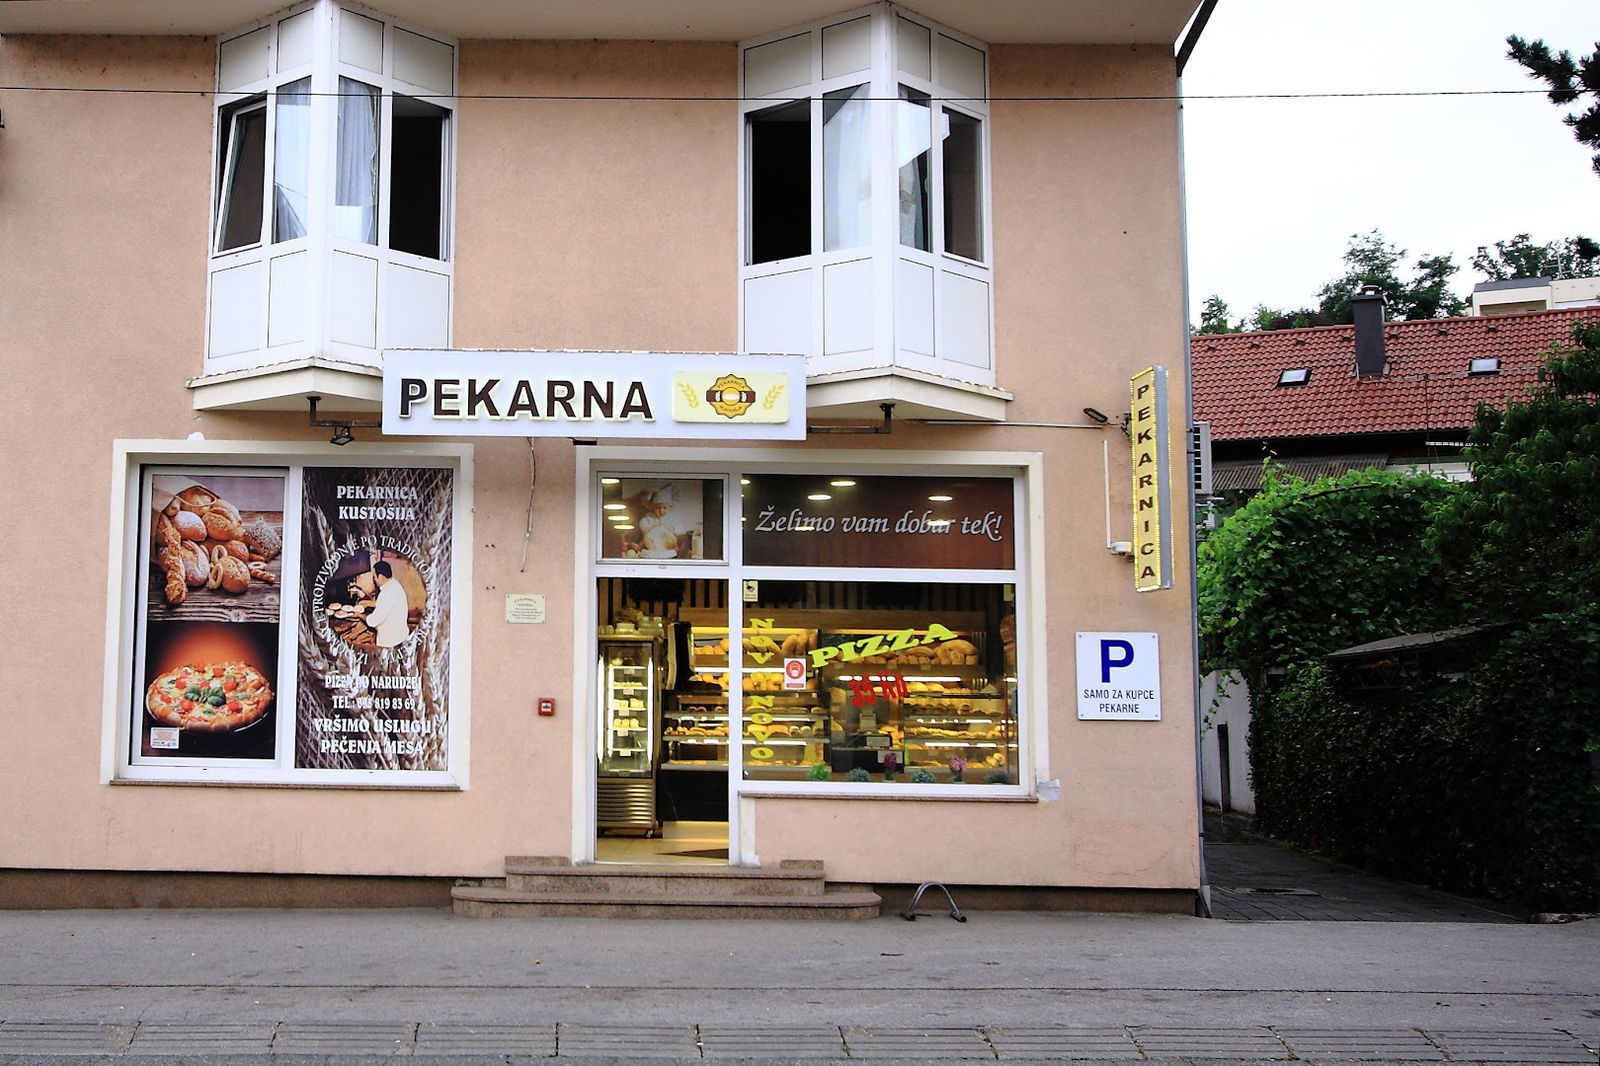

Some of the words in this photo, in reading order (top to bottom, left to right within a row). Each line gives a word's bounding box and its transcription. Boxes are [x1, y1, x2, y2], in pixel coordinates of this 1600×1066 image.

[399, 378, 655, 421] PEKARNA
[1136, 384, 1156, 579] PEKARNICA
[336, 485, 418, 500] PEKARNICA
[338, 503, 416, 520] KUSTOŠIJA
[754, 505, 836, 533] Želimo
[841, 515, 890, 533] vam
[894, 508, 956, 534] dobar
[961, 510, 1003, 542] tek!
[360, 535, 377, 548] PO
[808, 624, 958, 668] PIZZA
[1100, 639, 1134, 683] P
[374, 697, 391, 710] 819
[404, 698, 416, 710] 69
[1083, 689, 1109, 699] SAMO
[1112, 689, 1123, 699] ZA
[1126, 690, 1155, 700] KUPCE
[1099, 703, 1140, 713] PEKARNE
[314, 714, 370, 733] VRŠIMO
[374, 719, 431, 734] USLUGU
[320, 735, 380, 754] PEČENJA
[384, 741, 424, 754] MESA
